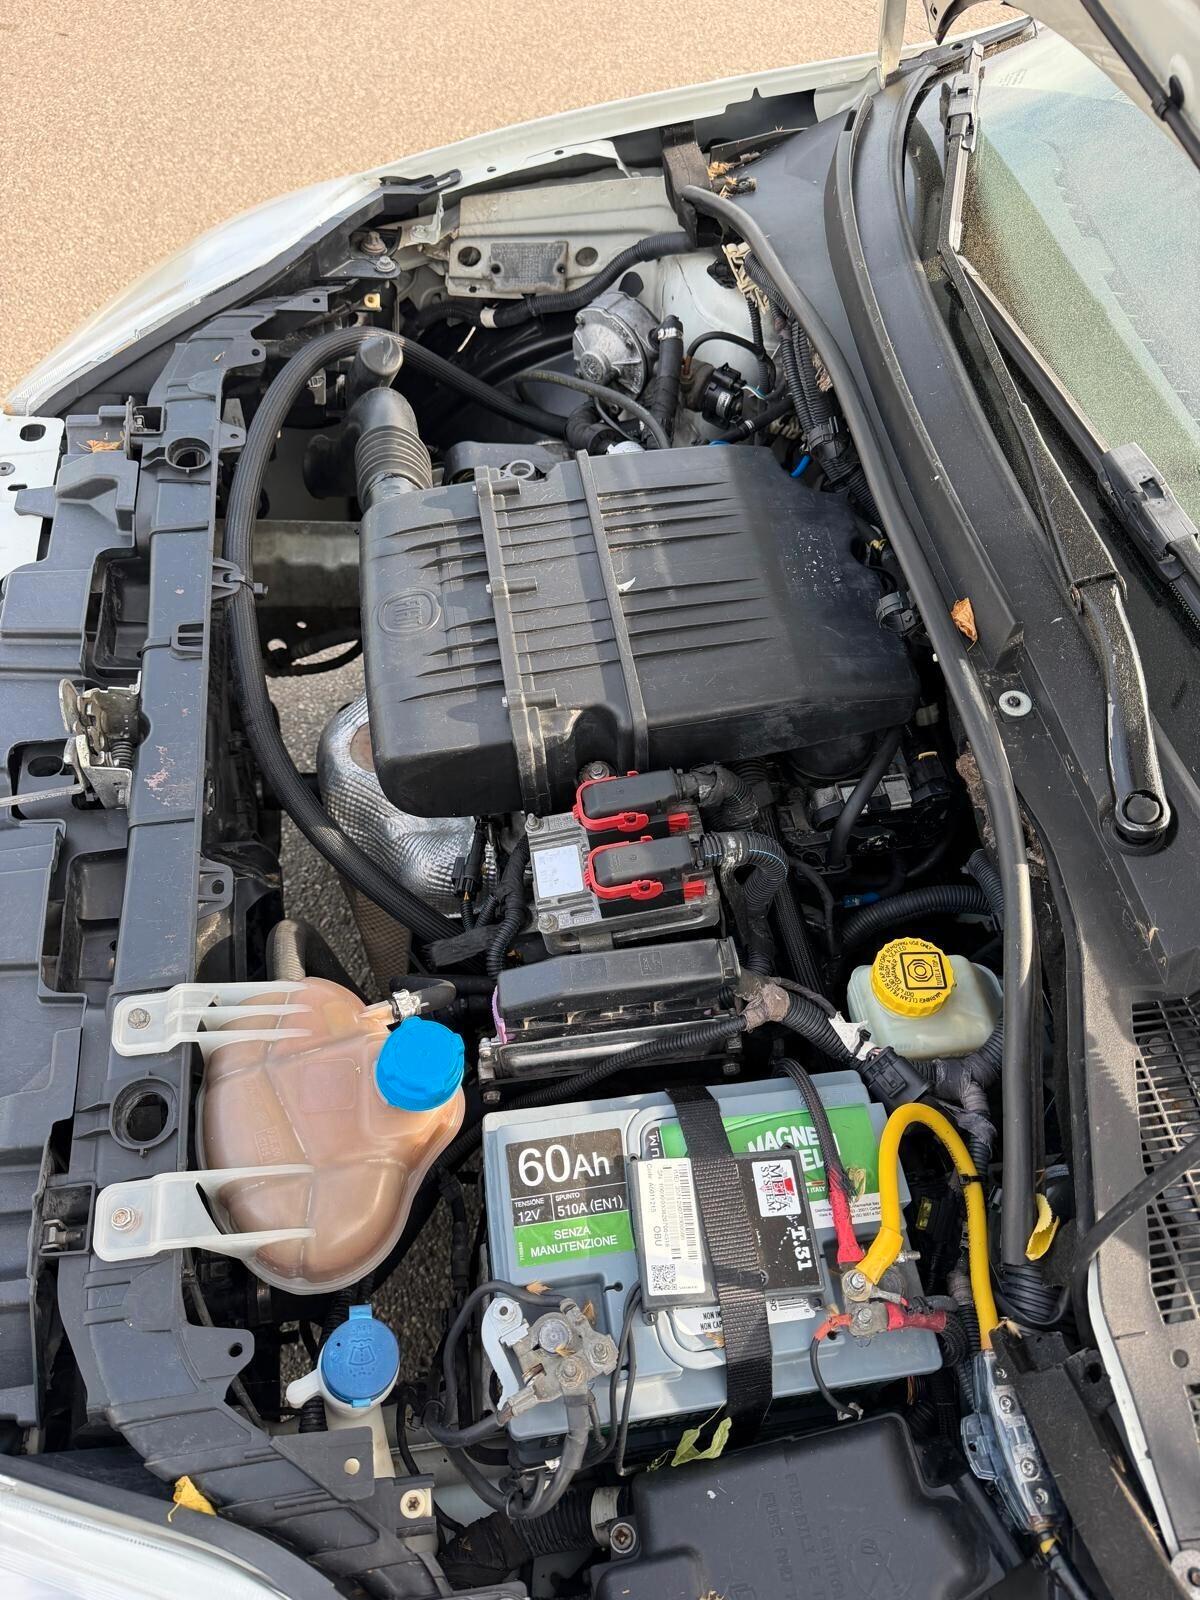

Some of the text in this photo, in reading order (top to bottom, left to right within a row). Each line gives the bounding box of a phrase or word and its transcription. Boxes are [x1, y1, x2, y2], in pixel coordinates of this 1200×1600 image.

[885, 940, 908, 954] REMOVING
[889, 945, 906, 959] SEALED
[920, 941, 932, 950] ONLY
[878, 954, 888, 970] BEFORE
[884, 982, 900, 997] FILLER
[900, 996, 918, 1004] CLEAN
[518, 1144, 610, 1186] 60Ah
[761, 1166, 776, 1212] SYSTEM
[769, 1164, 789, 1212] META
[810, 1186, 826, 1194] ITALY
[514, 1198, 544, 1208] TENSIONE
[555, 1192, 580, 1202] SPUNTO
[558, 1195, 623, 1217] 510A (EN1)
[518, 1209, 540, 1222] 12V
[554, 1226, 591, 1240] SENZA
[654, 1225, 663, 1247] OBU
[530, 1235, 618, 1258] MANUTENZIONE
[791, 1226, 812, 1271] T.31
[703, 1312, 715, 1320] NON
[700, 1322, 712, 1330] NON
